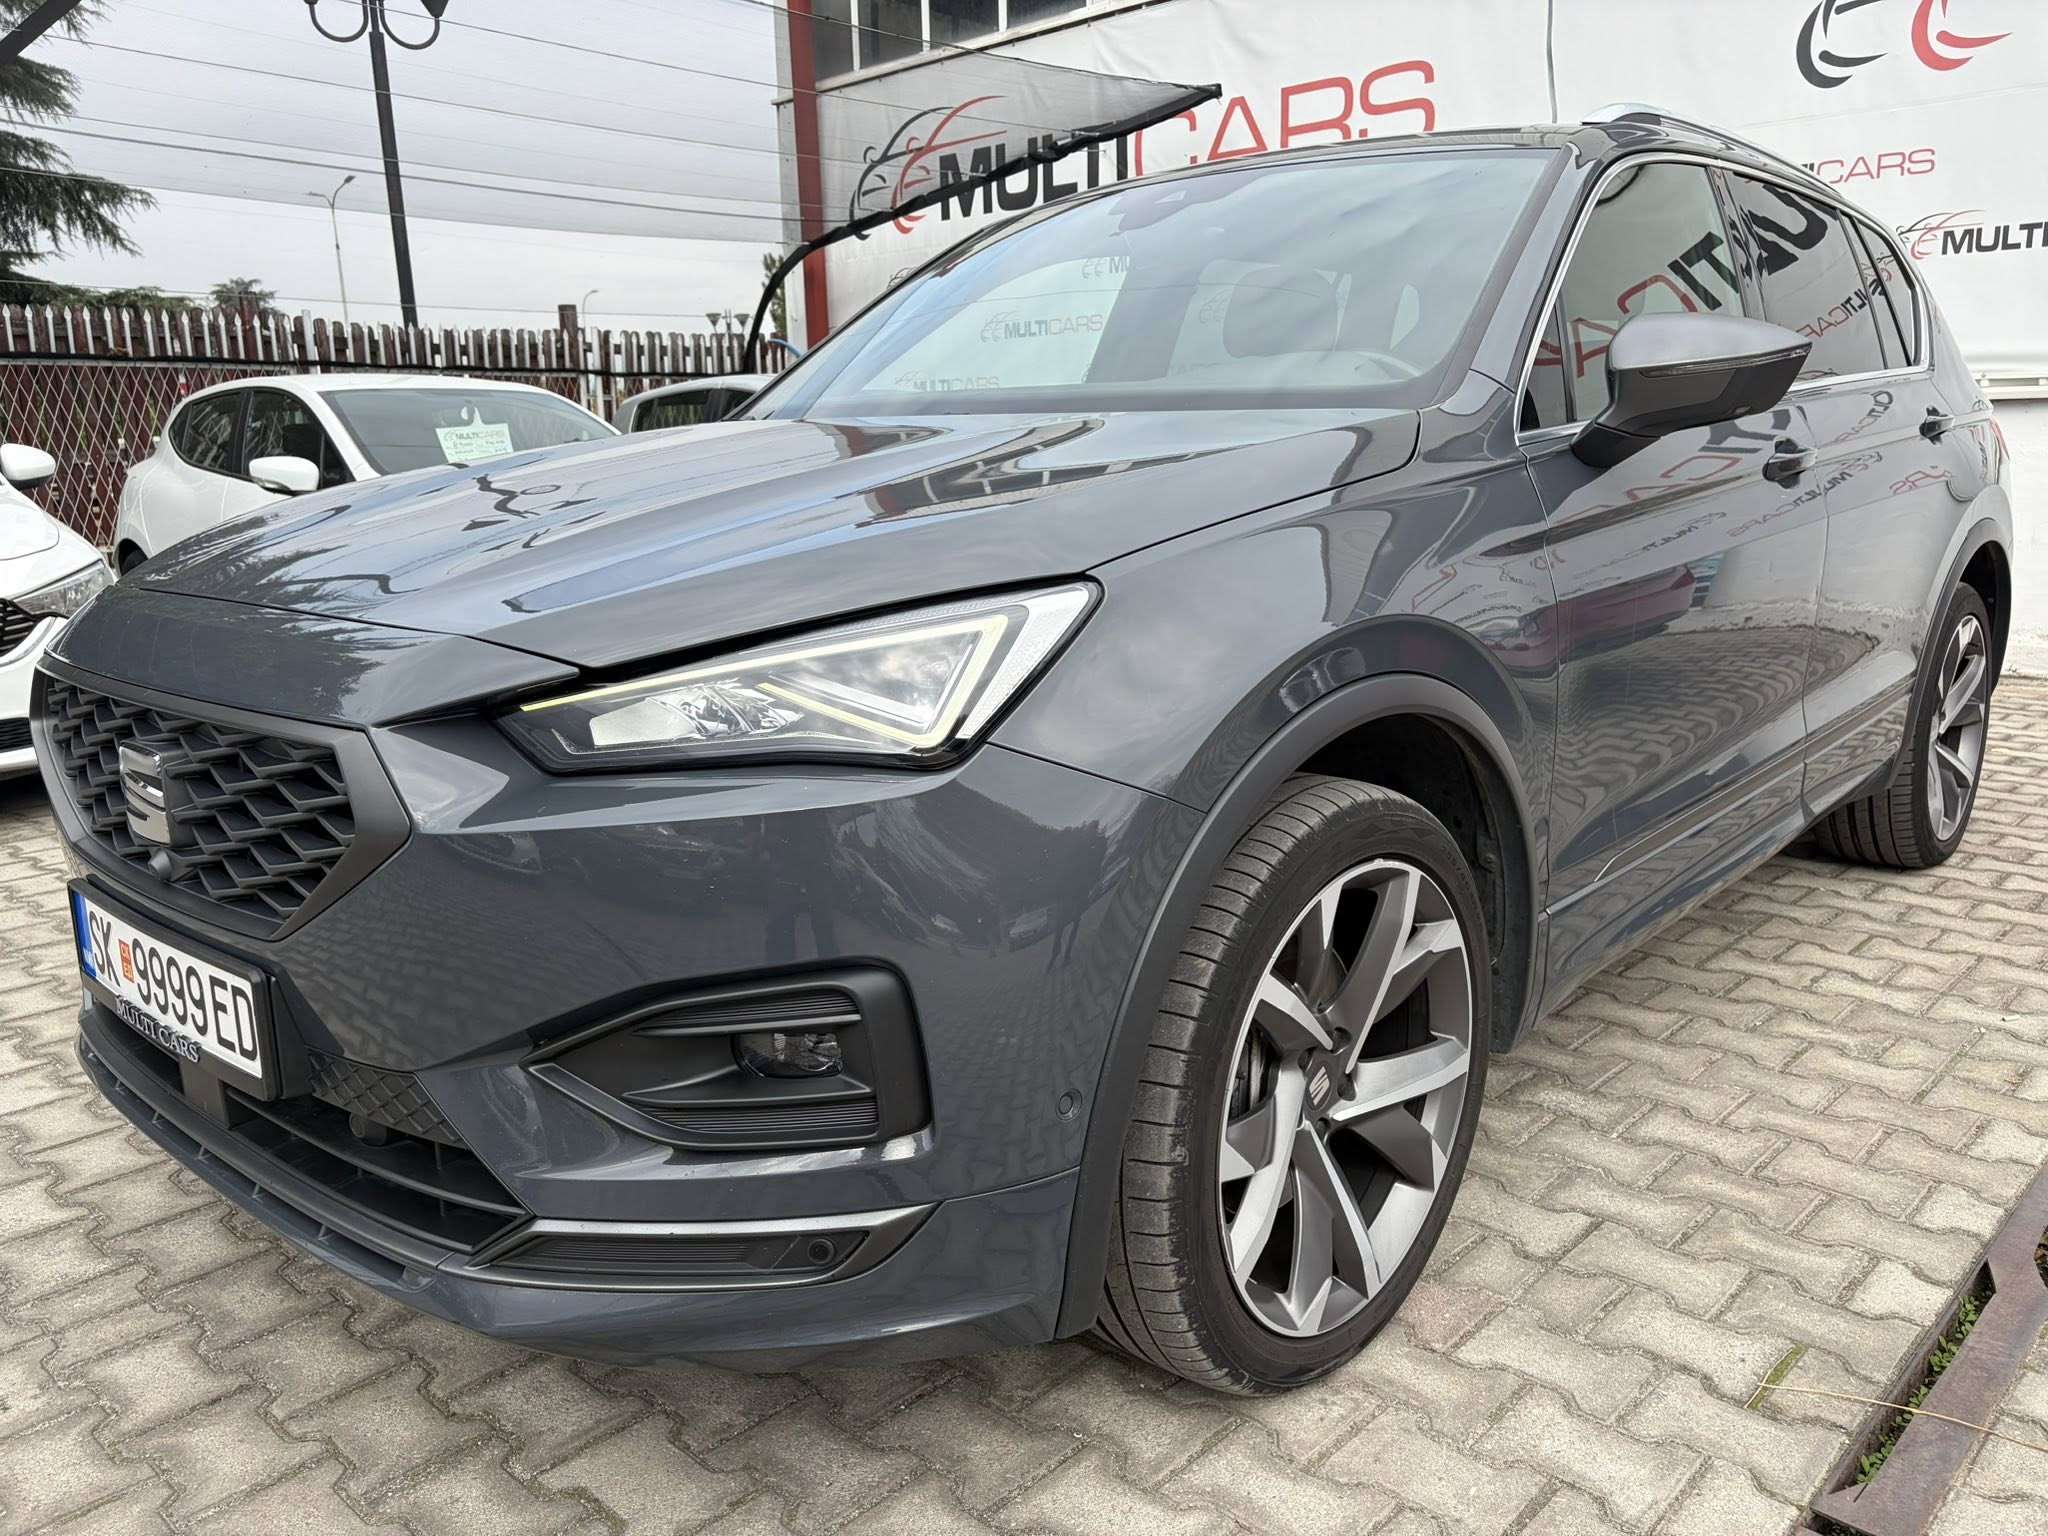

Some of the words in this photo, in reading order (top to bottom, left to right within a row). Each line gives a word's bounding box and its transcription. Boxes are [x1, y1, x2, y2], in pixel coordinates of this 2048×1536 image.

[1003, 313, 1104, 341] MULTICARS
[88, 910, 121, 988] SK
[158, 1027, 200, 1063] CARS
